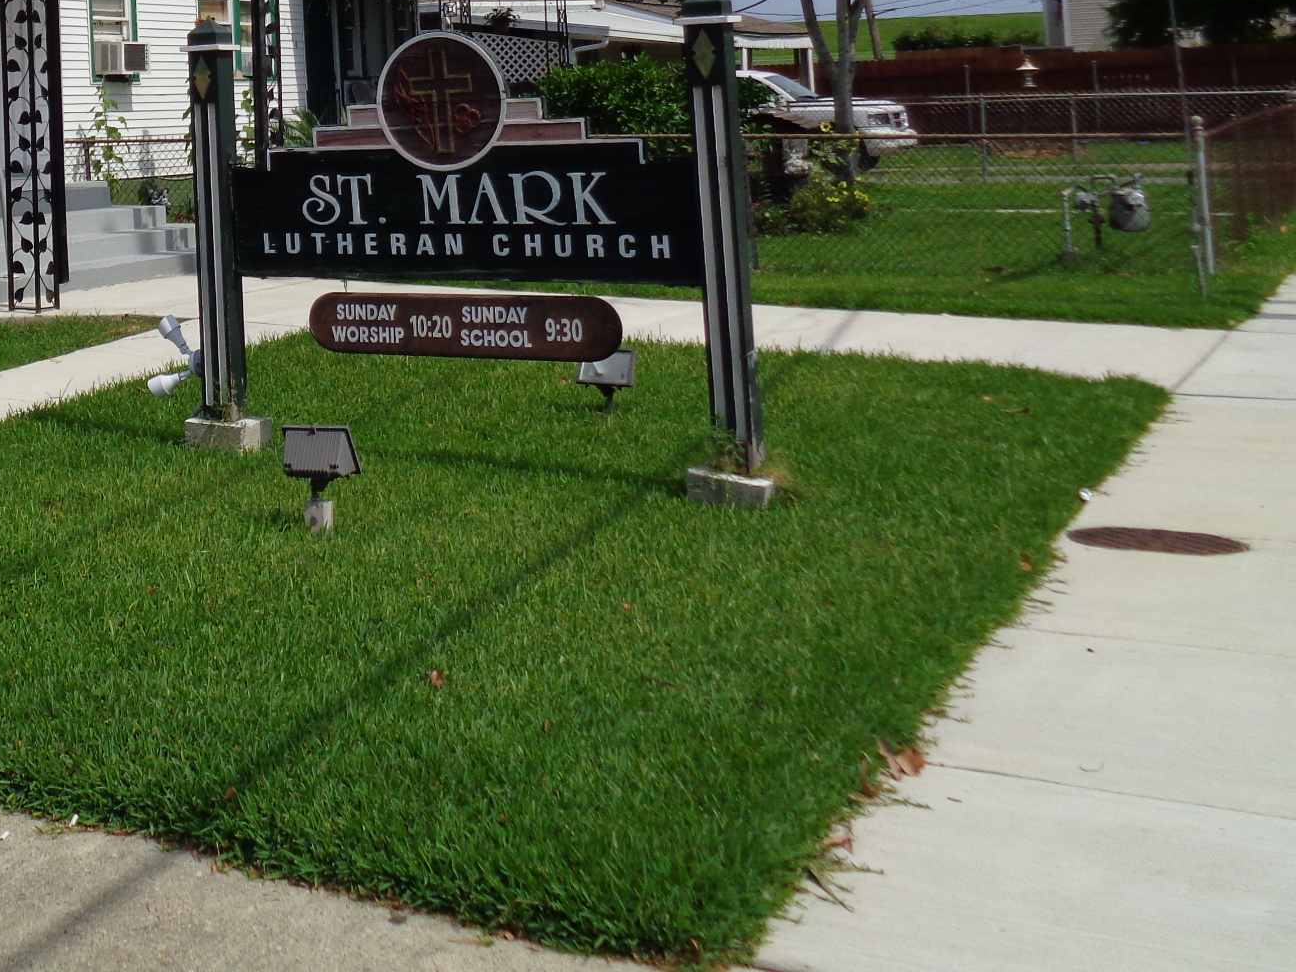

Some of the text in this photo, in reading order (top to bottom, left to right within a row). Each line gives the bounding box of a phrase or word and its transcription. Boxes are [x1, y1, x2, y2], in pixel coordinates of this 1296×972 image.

[302, 170, 616, 226] ST. MARK
[263, 232, 671, 259] LUTHERAN CHURCH
[336, 304, 397, 321] SUNDAY
[461, 306, 527, 324] SUNDAY
[332, 326, 405, 344] WORSHIP
[409, 314, 452, 339] 10:20
[545, 318, 583, 343] 9:30
[460, 329, 533, 348] SCHOOL
